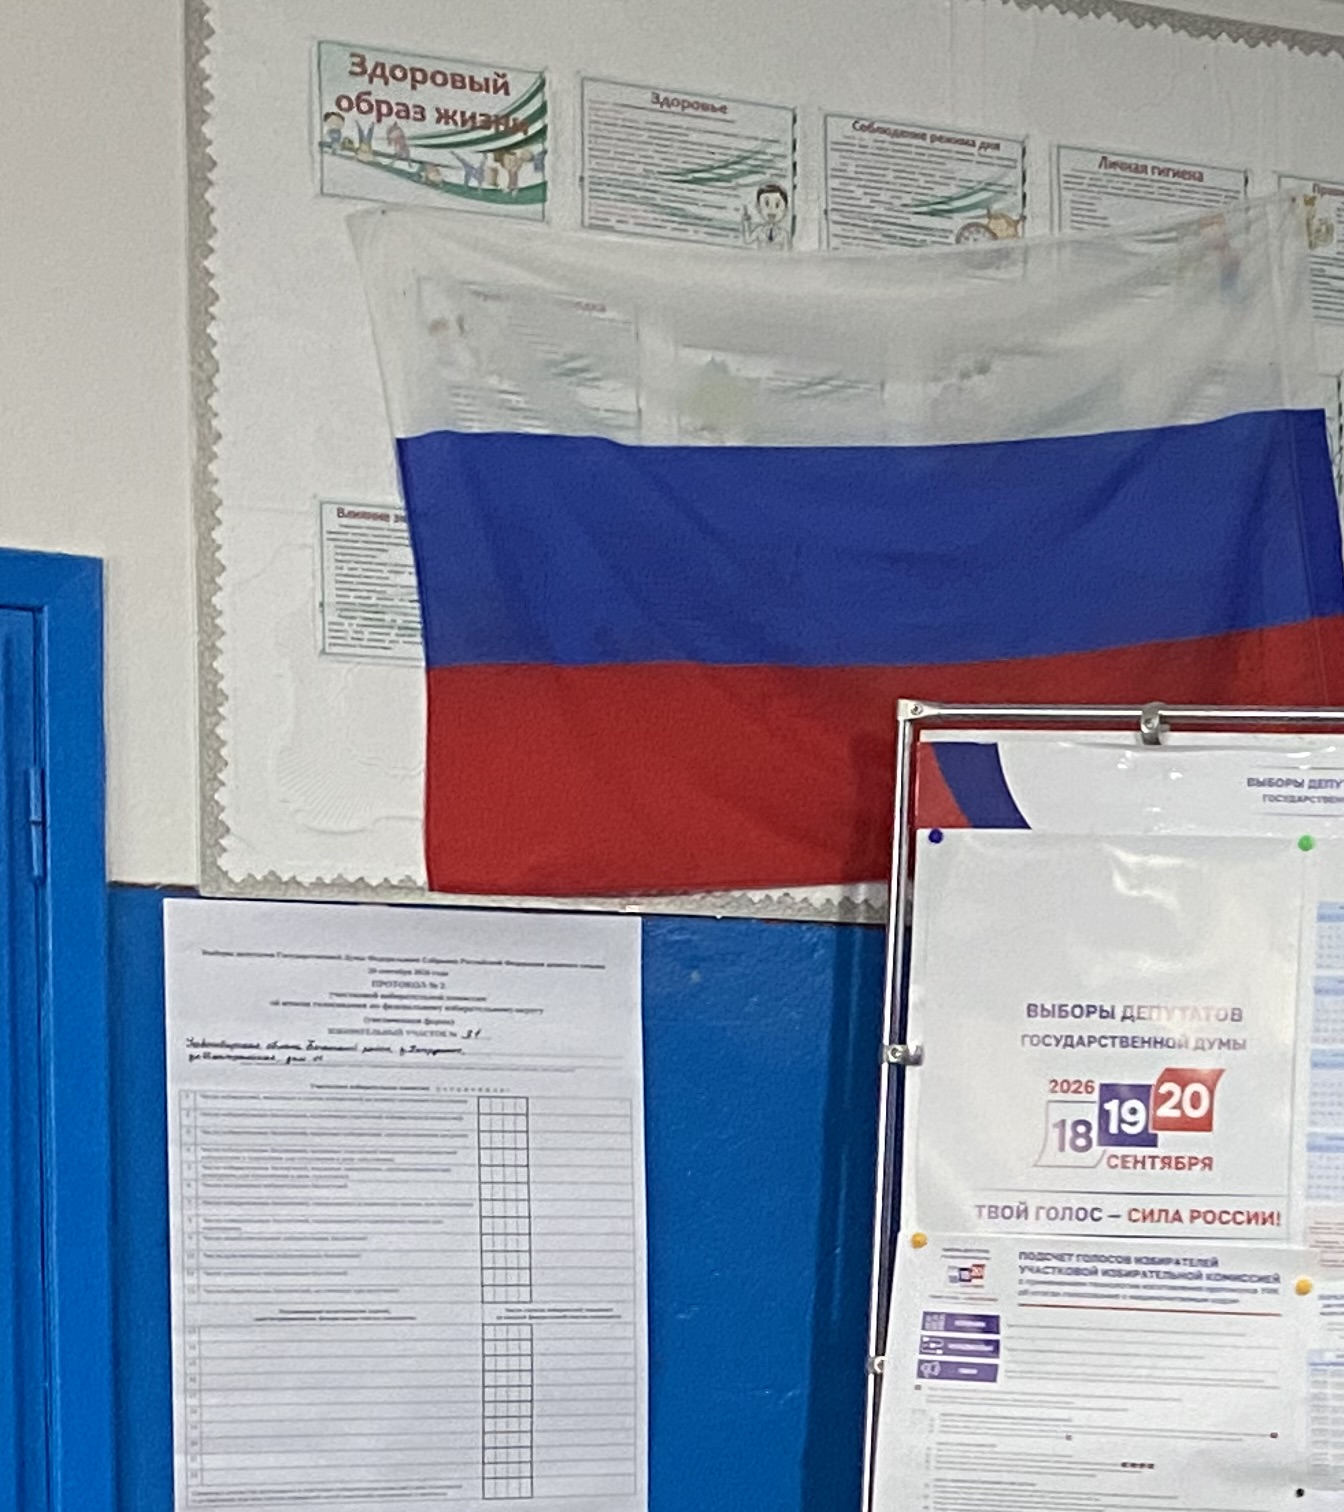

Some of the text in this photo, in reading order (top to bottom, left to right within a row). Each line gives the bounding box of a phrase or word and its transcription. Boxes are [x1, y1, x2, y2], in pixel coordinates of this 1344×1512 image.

[348, 52, 511, 96] Здоровый
[335, 90, 529, 136] образ жизни
[651, 91, 728, 115] Здоровье
[1098, 155, 1204, 183] Личная гигиена
[1247, 777, 1305, 790] ВЫБОРЫ
[1026, 1003, 1243, 1023] ВЫБОРЫ ДЕПУТАТОВ
[1021, 1034, 1247, 1052] ГОСУДАРСТВЕННОЙ ДУМЫ
[1049, 1079, 1096, 1095] 2026
[1155, 1082, 1211, 1118] 20
[1103, 1099, 1146, 1135] 19
[1052, 1119, 1093, 1153] 18
[1106, 1154, 1214, 1172] СЕНТЯБРЯ
[975, 1201, 1029, 1221] ТВОЙ
[1035, 1205, 1103, 1222] ГОЛОС
[1127, 1208, 1183, 1225] СИЛА
[1189, 1209, 1281, 1227] РОССИИ!
